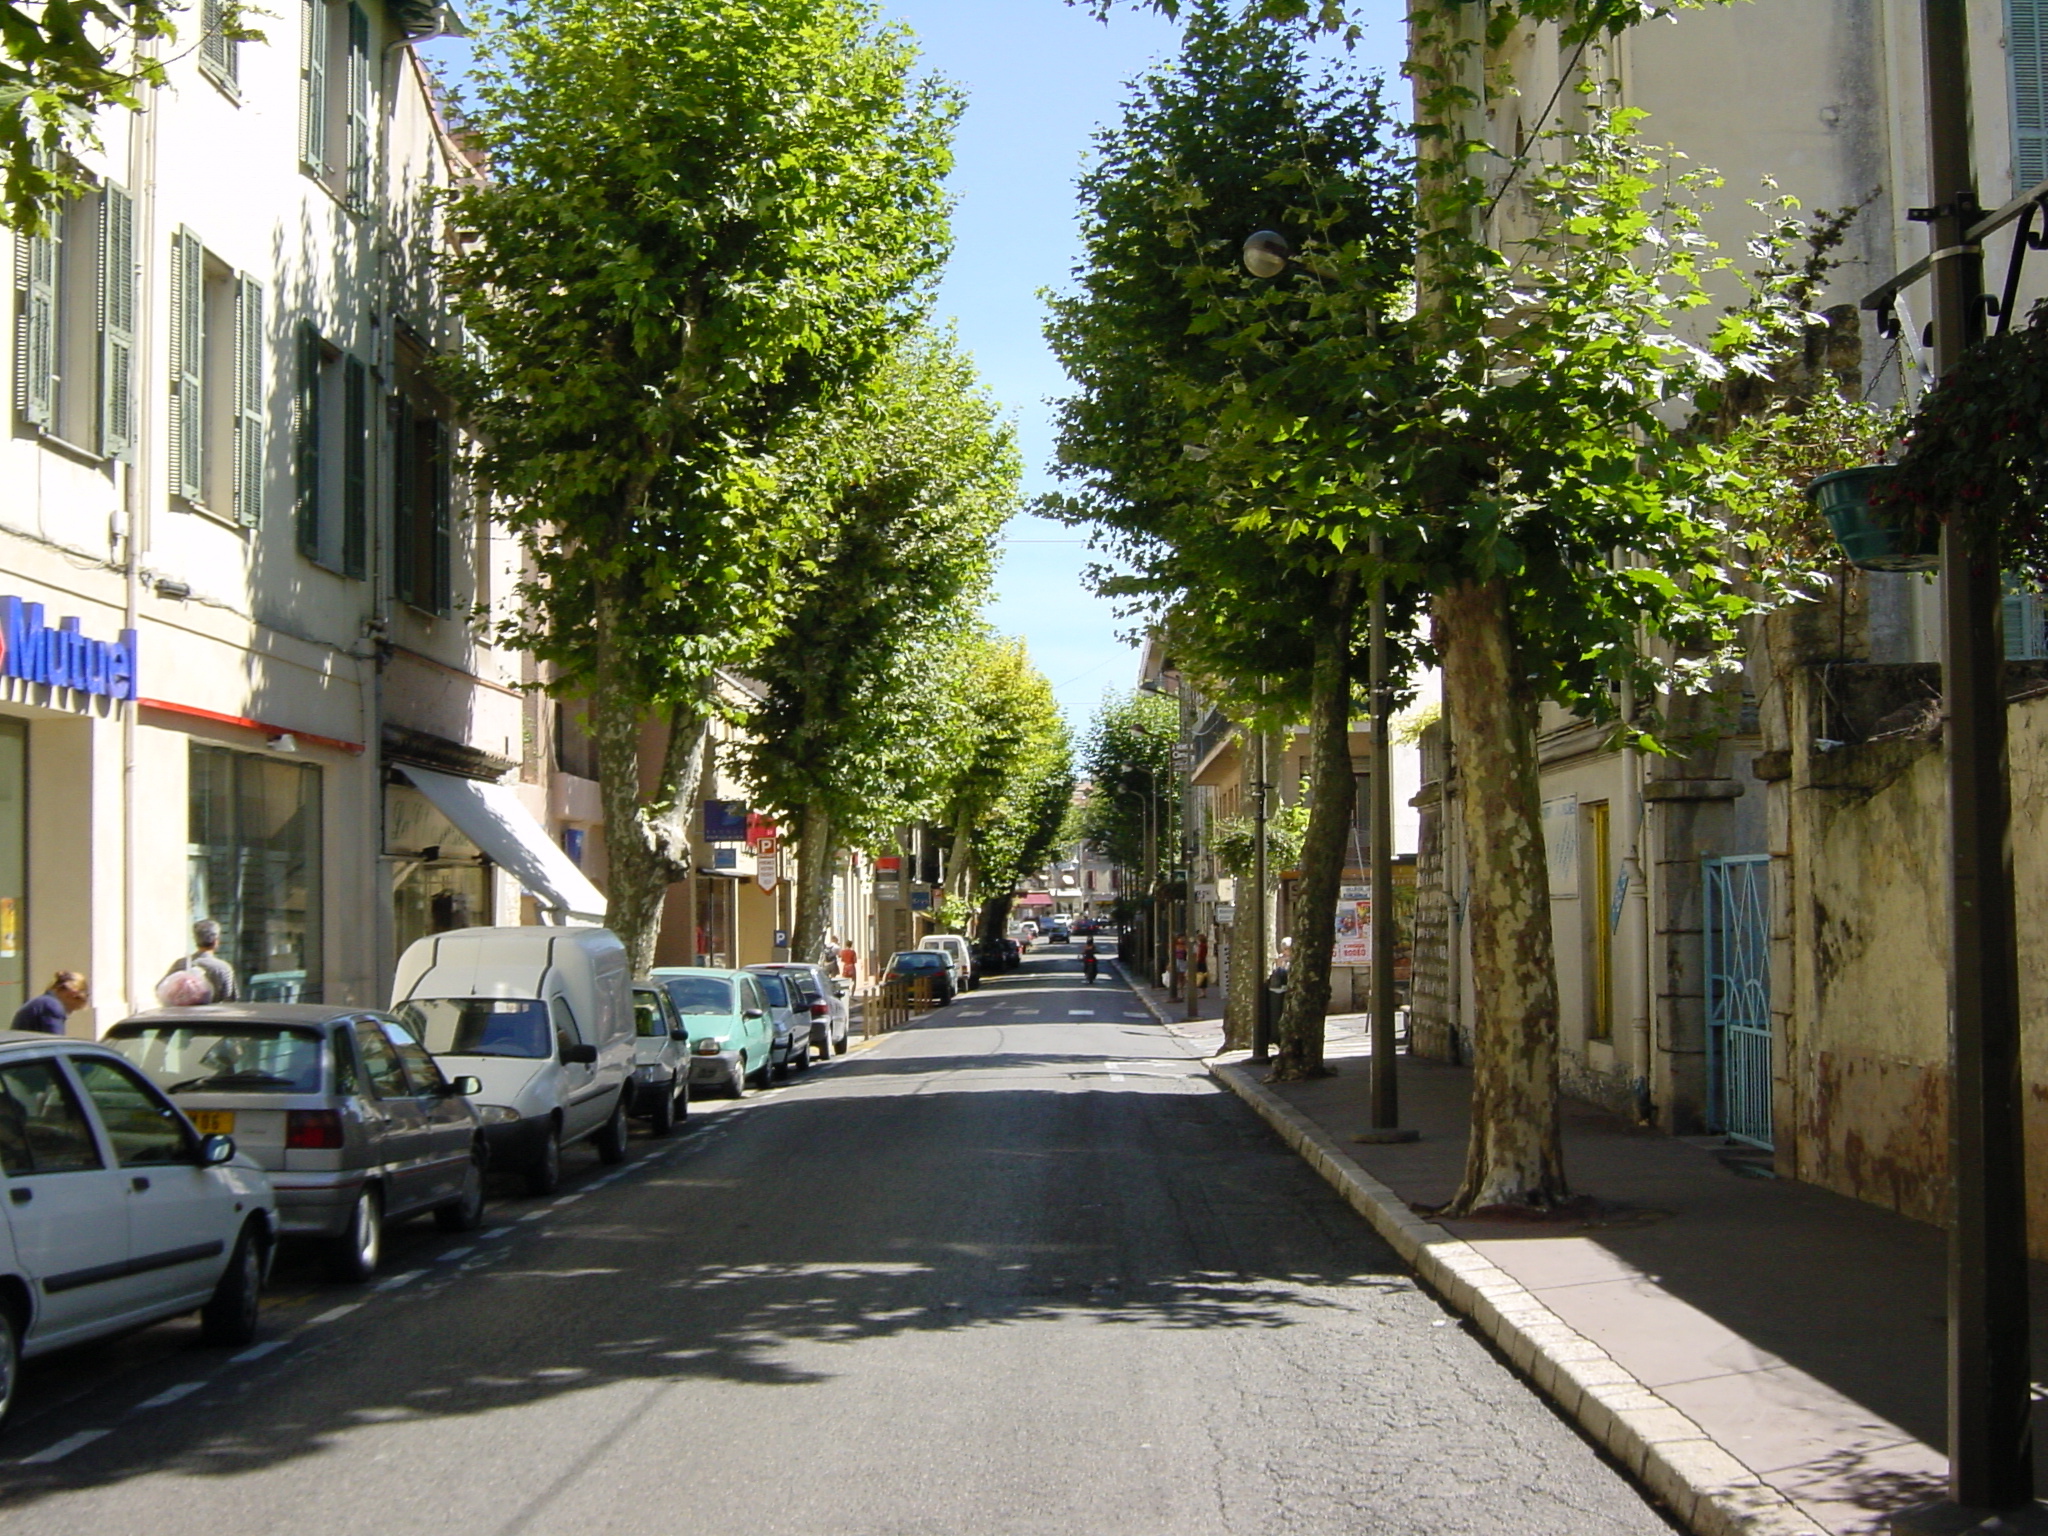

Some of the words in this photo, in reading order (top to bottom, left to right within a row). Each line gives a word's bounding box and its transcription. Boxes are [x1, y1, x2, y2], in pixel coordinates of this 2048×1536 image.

[3, 595, 137, 700] Mutuel
[761, 840, 772, 853] P
[776, 932, 785, 944] P
